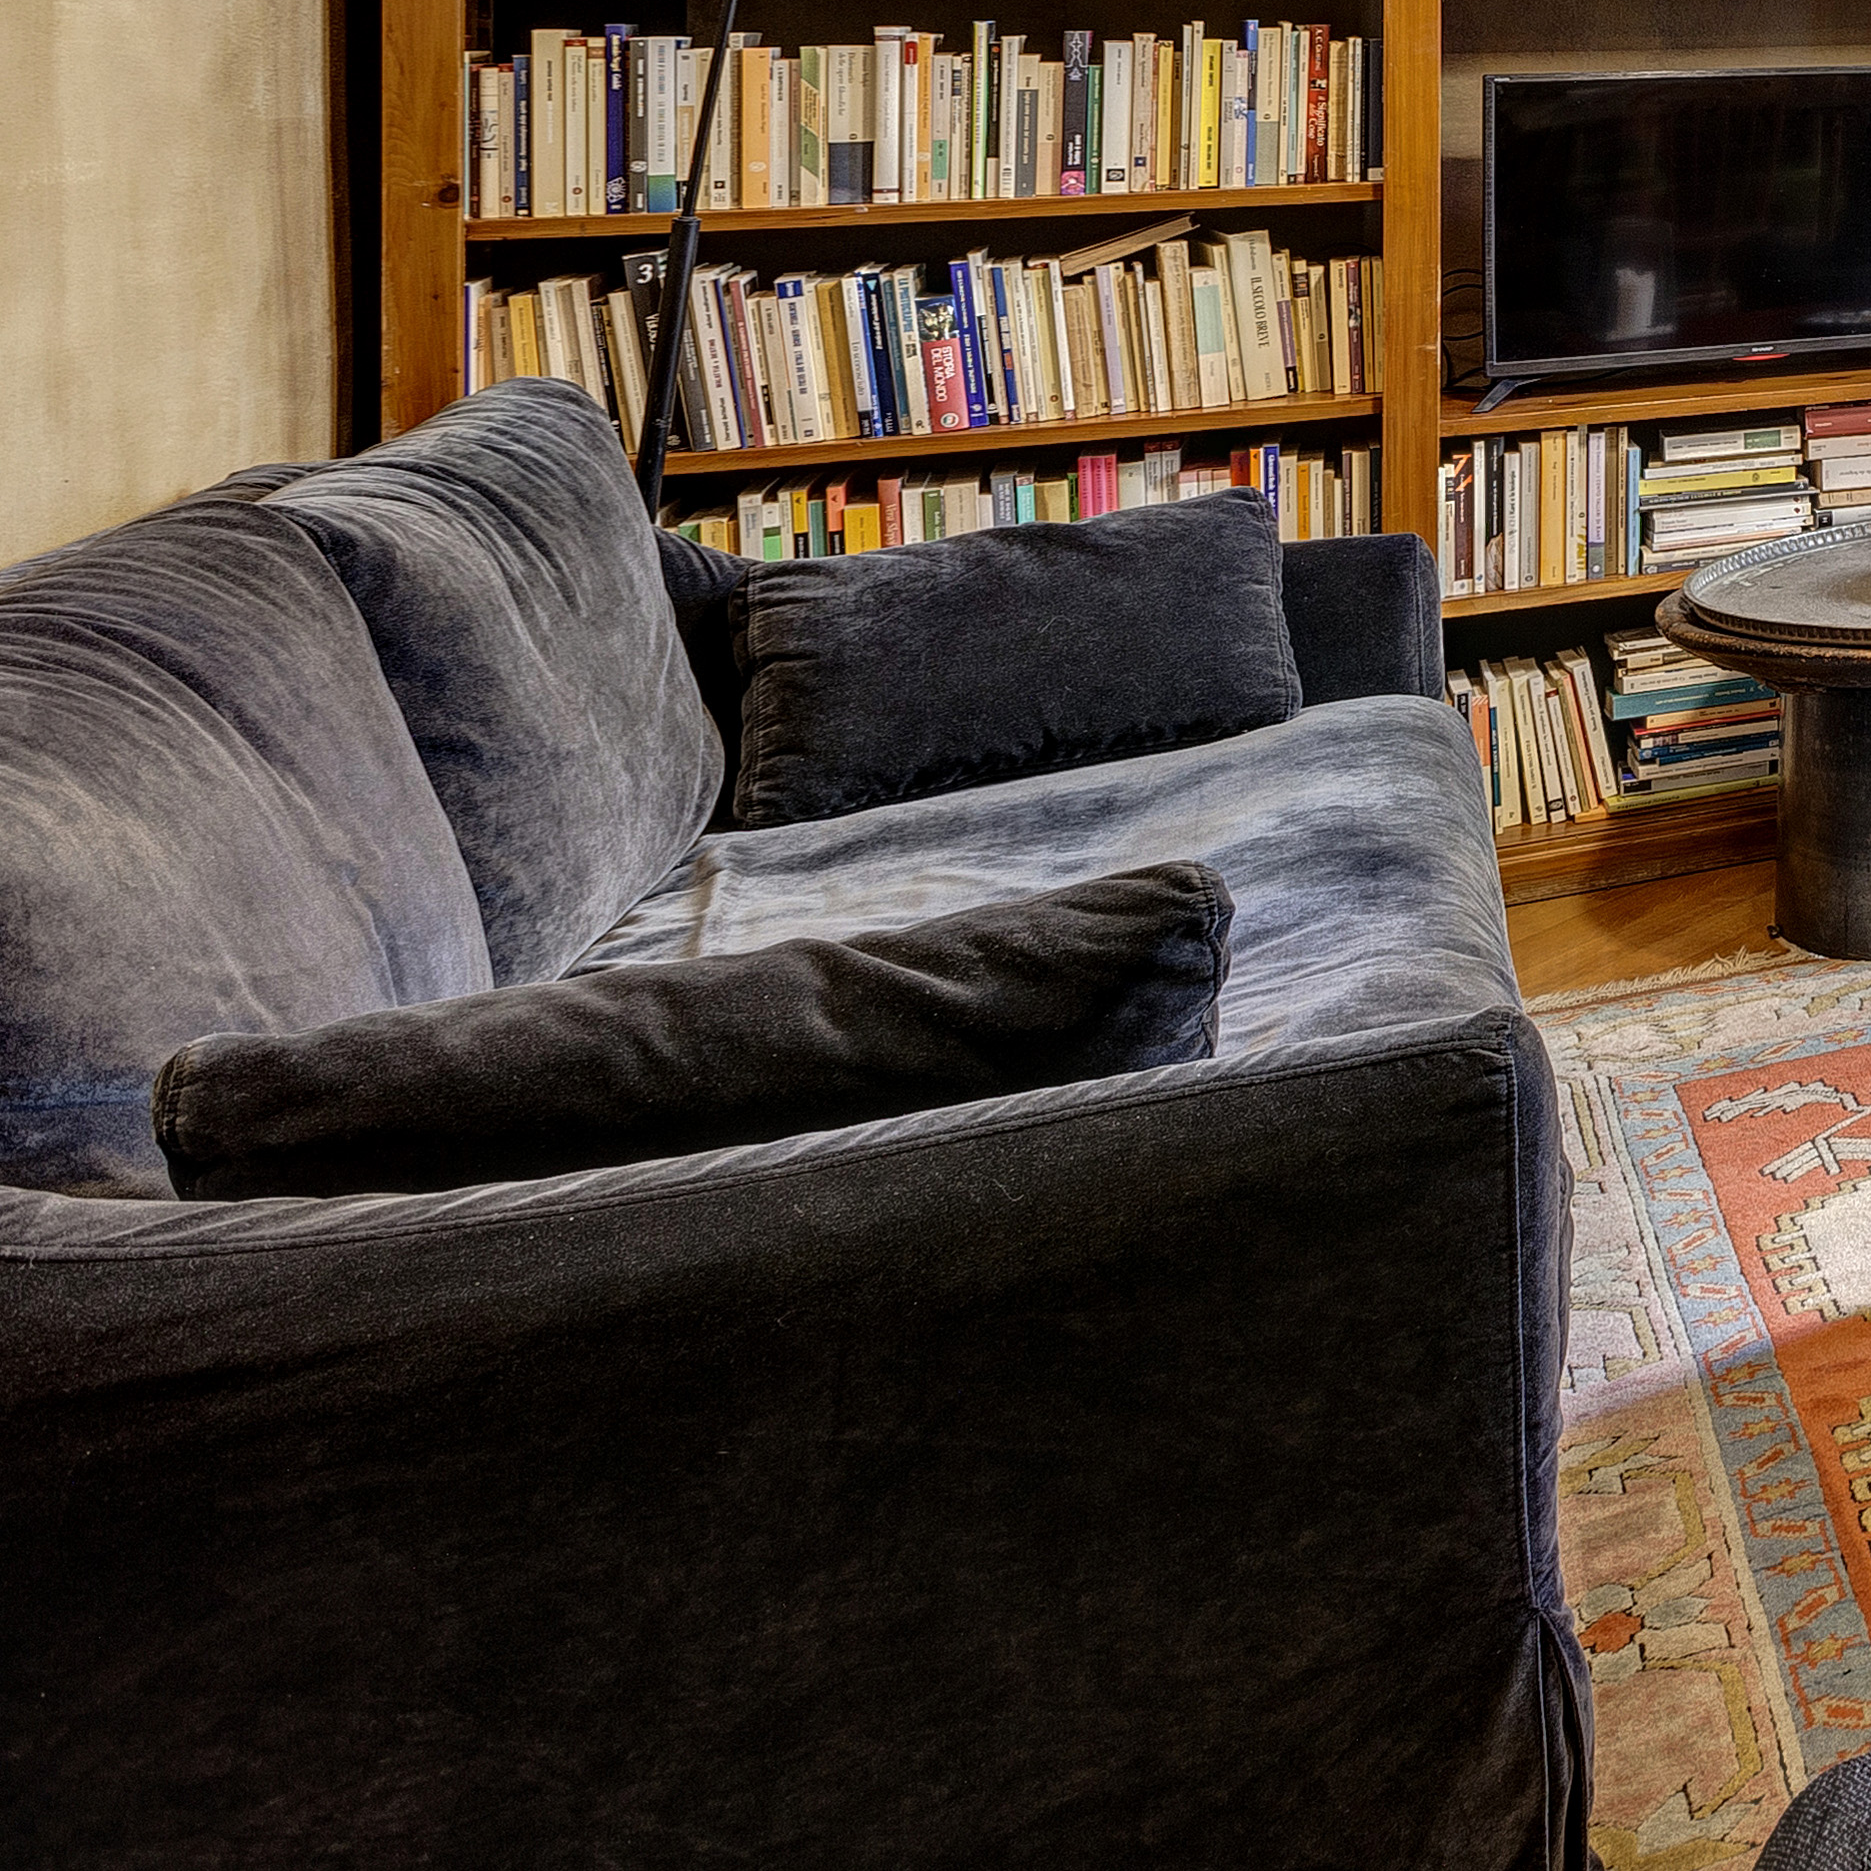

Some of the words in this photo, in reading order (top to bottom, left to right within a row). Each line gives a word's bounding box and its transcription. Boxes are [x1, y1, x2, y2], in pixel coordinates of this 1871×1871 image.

[1253, 285, 1267, 319] SECOLO
[1256, 320, 1270, 349] BREVE
[932, 346, 943, 365] DEL
[943, 345, 956, 379] STORIA
[933, 366, 947, 402] MONDO
